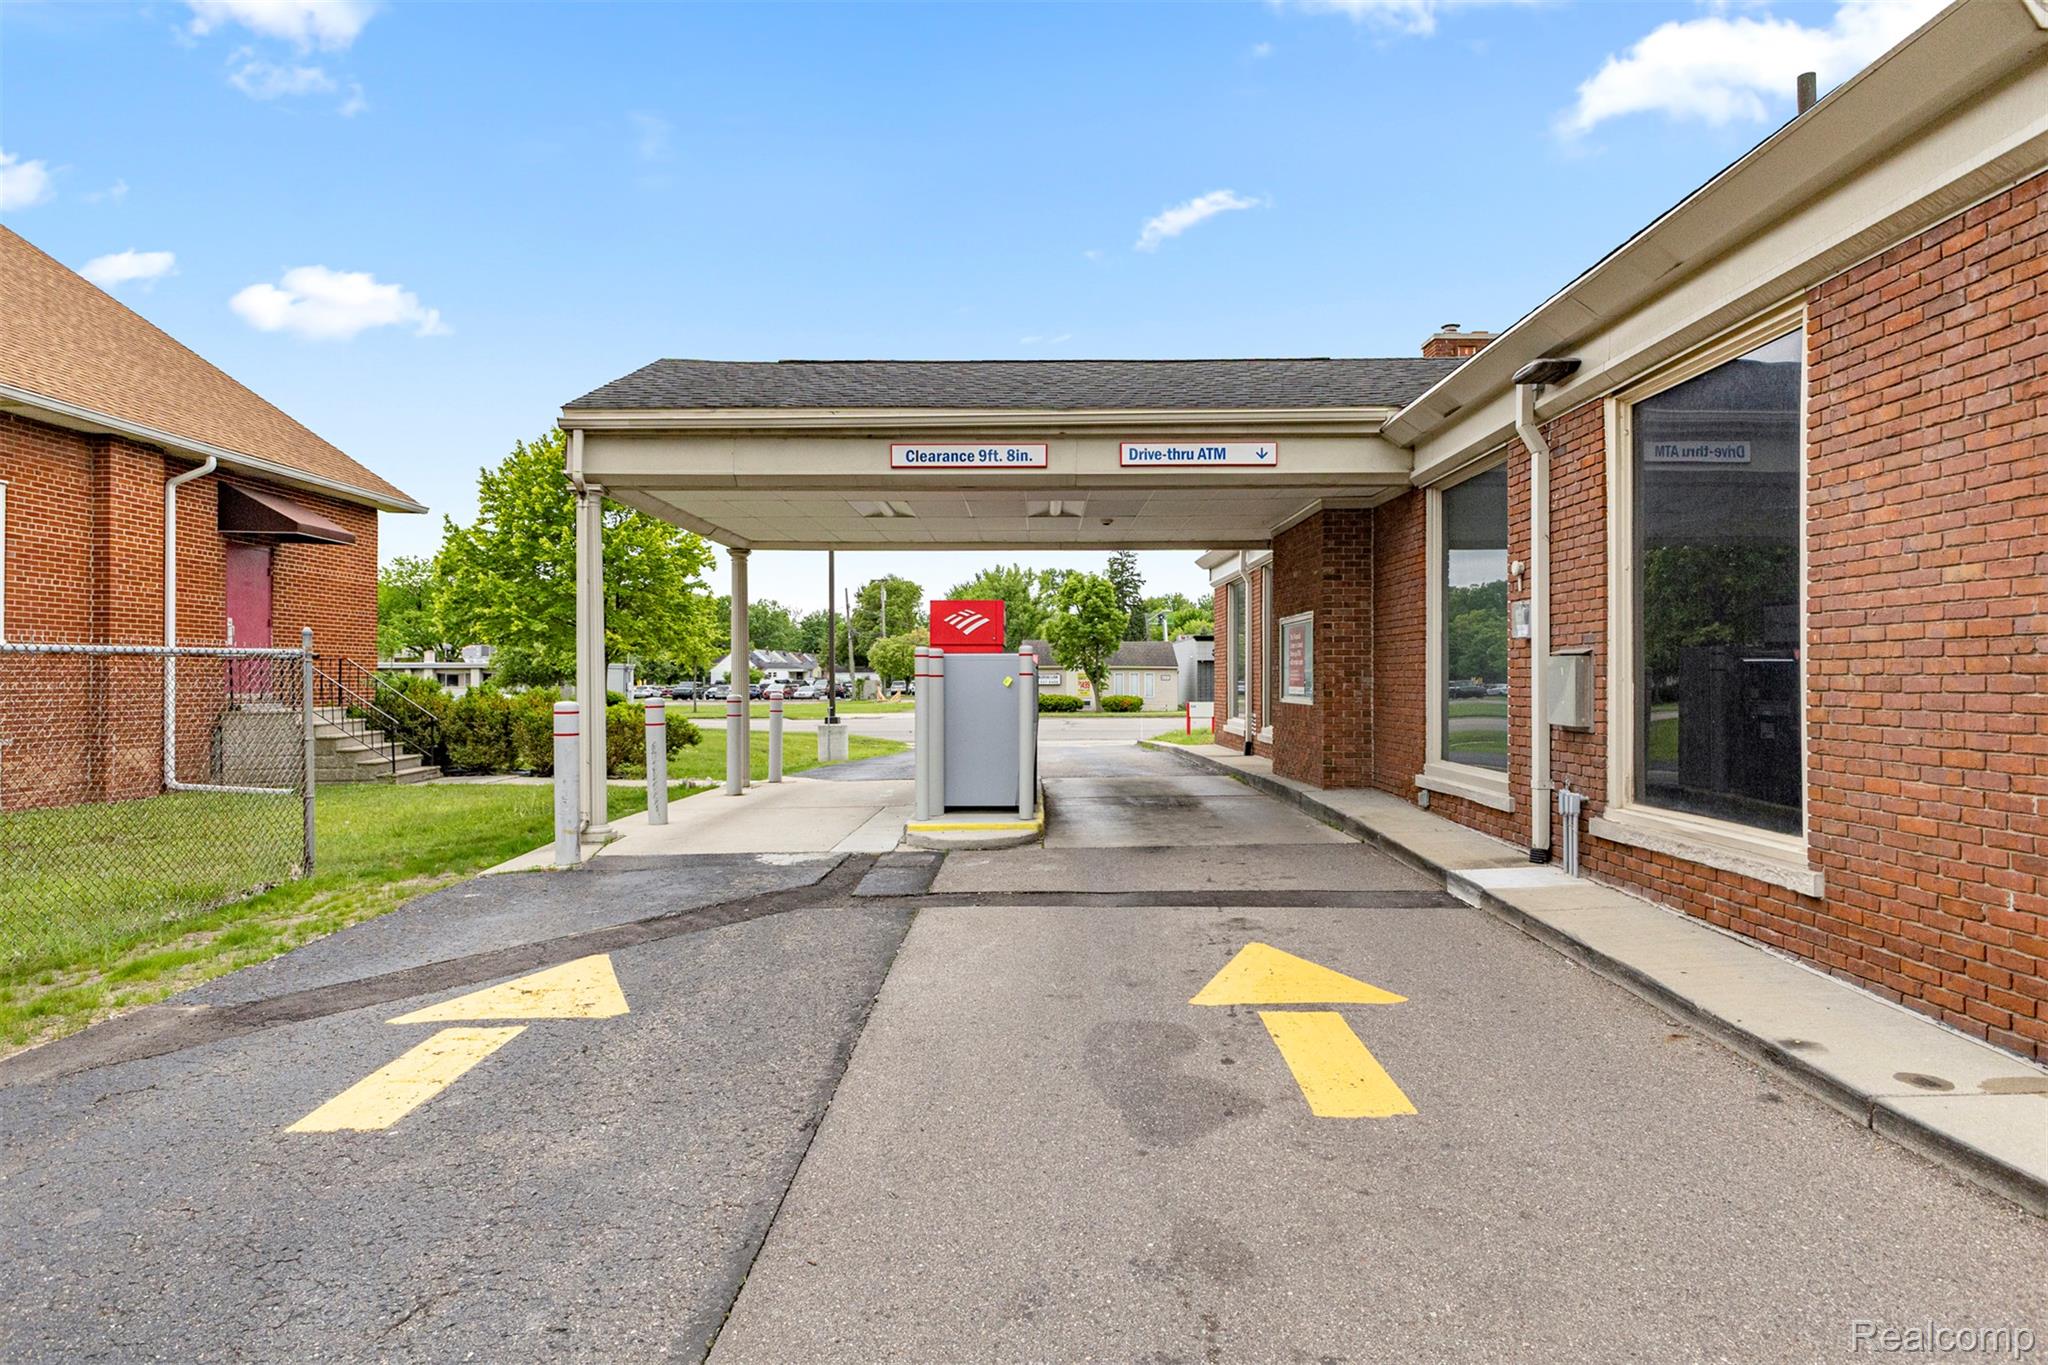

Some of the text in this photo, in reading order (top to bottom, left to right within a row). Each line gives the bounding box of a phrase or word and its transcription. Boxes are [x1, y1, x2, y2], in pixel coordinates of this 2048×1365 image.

[905, 449, 1033, 463] Clearance 9ft. 8in.
[1128, 447, 1226, 461] Drive-thru ATM
